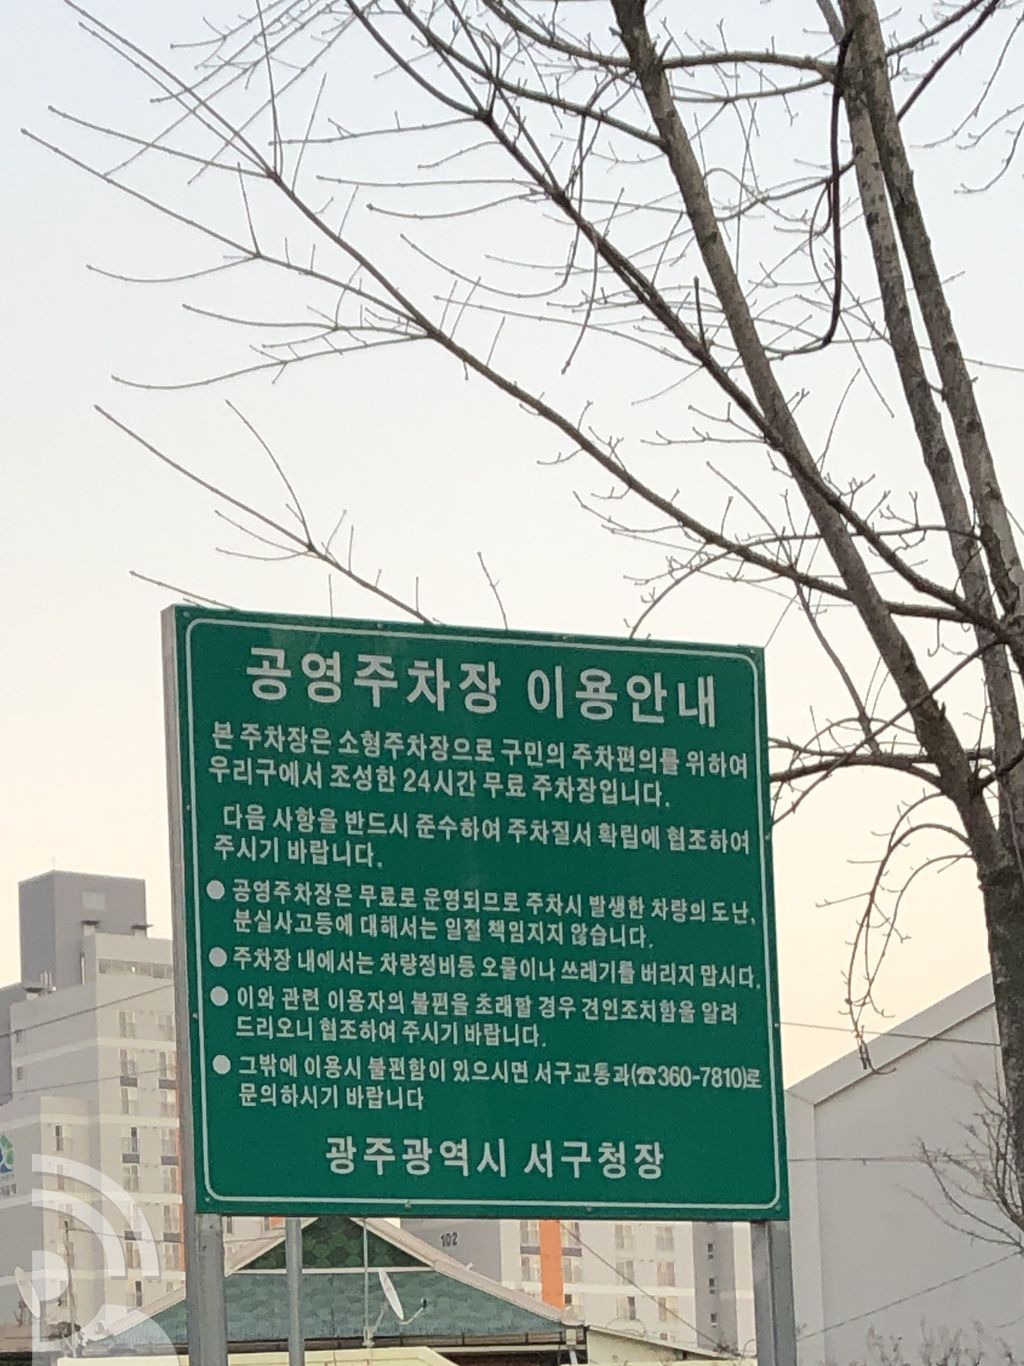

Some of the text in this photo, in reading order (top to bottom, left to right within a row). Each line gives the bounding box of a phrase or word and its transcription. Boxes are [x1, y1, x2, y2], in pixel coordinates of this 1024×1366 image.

[247, 648, 715, 727] 공영주차장 이용안내
[212, 722, 747, 778] 본 주차장은 소형주차장으로 구민의 주차편의를 위하여
[210, 756, 669, 806] 우리구에서 조성한 24시간 무료 주차장입니다.
[224, 804, 749, 854] 다음 사항을 반드시 준수하여 주차질서 확립에 협조하여
[214, 835, 381, 867] 주시기 바랍니다.
[233, 879, 352, 906] 공영주차장은
[359, 885, 417, 907] 무료로
[424, 888, 520, 912] 운영되므로
[526, 893, 581, 916] 주차시
[590, 896, 644, 918] 발생한
[651, 898, 705, 922] 차량의
[234, 909, 352, 936] 분실사고등에
[361, 914, 437, 939] 대해서는
[489, 920, 563, 944] 책임지지
[234, 947, 291, 971] 주차장
[298, 950, 374, 974] 내에서는
[381, 952, 475, 977] 차량정비등
[482, 957, 555, 981] 오물이나
[562, 960, 634, 984] 쓰레기를
[642, 963, 693, 986] 버리지
[238, 986, 736, 1024] 이와 관련 이용자의 불편을 초래할 경우 견인조치함을 알려
[237, 1016, 545, 1046] 드리오니 협조하여 주시기 바랍니다.
[239, 1054, 297, 1077] 그밖에
[305, 1055, 360, 1079] 이용시
[368, 1057, 445, 1081] 불편함이
[453, 1060, 528, 1083] 있으시면
[239, 1083, 423, 1109] 문의하시기 바랍니다
[326, 1136, 663, 1179] 광주광역시 서구청장
[440, 1231, 458, 1247] 102
